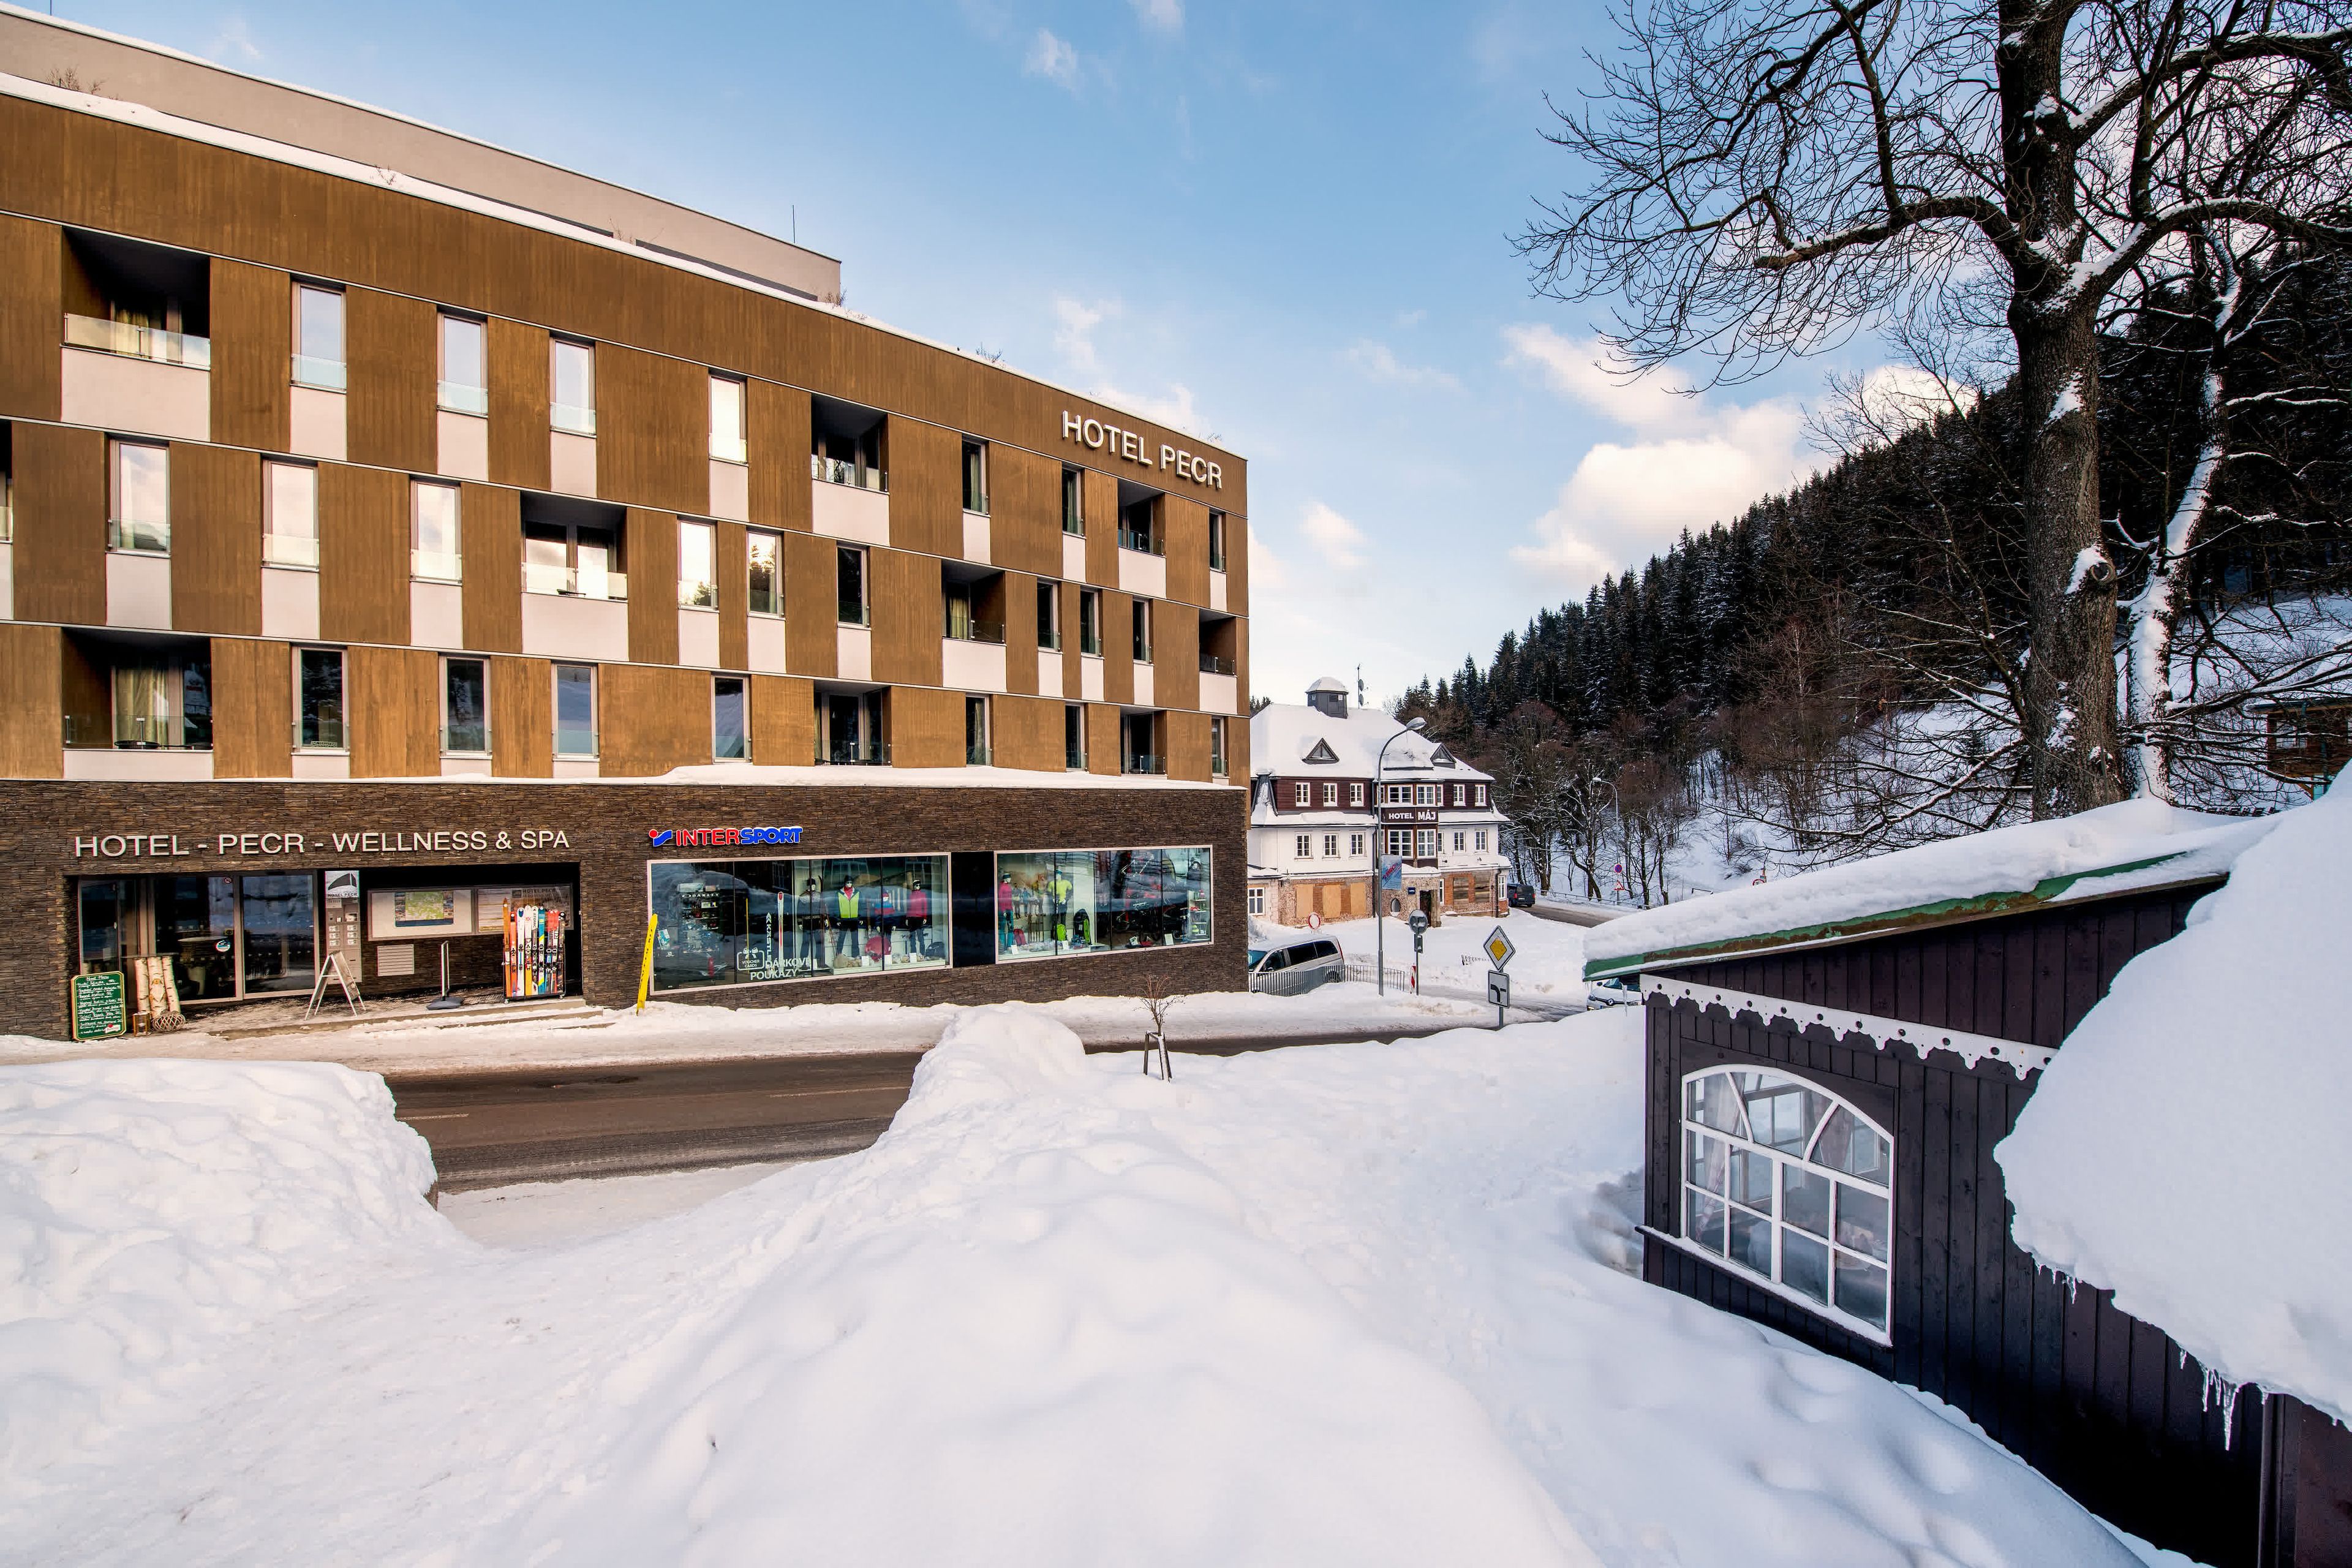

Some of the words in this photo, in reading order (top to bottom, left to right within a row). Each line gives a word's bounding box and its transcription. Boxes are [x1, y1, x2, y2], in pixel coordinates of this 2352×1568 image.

[1062, 410, 1153, 466] HOTEL
[1160, 444, 1223, 489] PECR
[1417, 809, 1436, 820] MÁJ
[75, 835, 190, 857] HOTEL
[218, 833, 305, 854] PECR
[332, 831, 488, 852] WELLNESS
[496, 831, 513, 850] &
[521, 830, 570, 850] SPA
[676, 827, 804, 846] INTERSPORT
